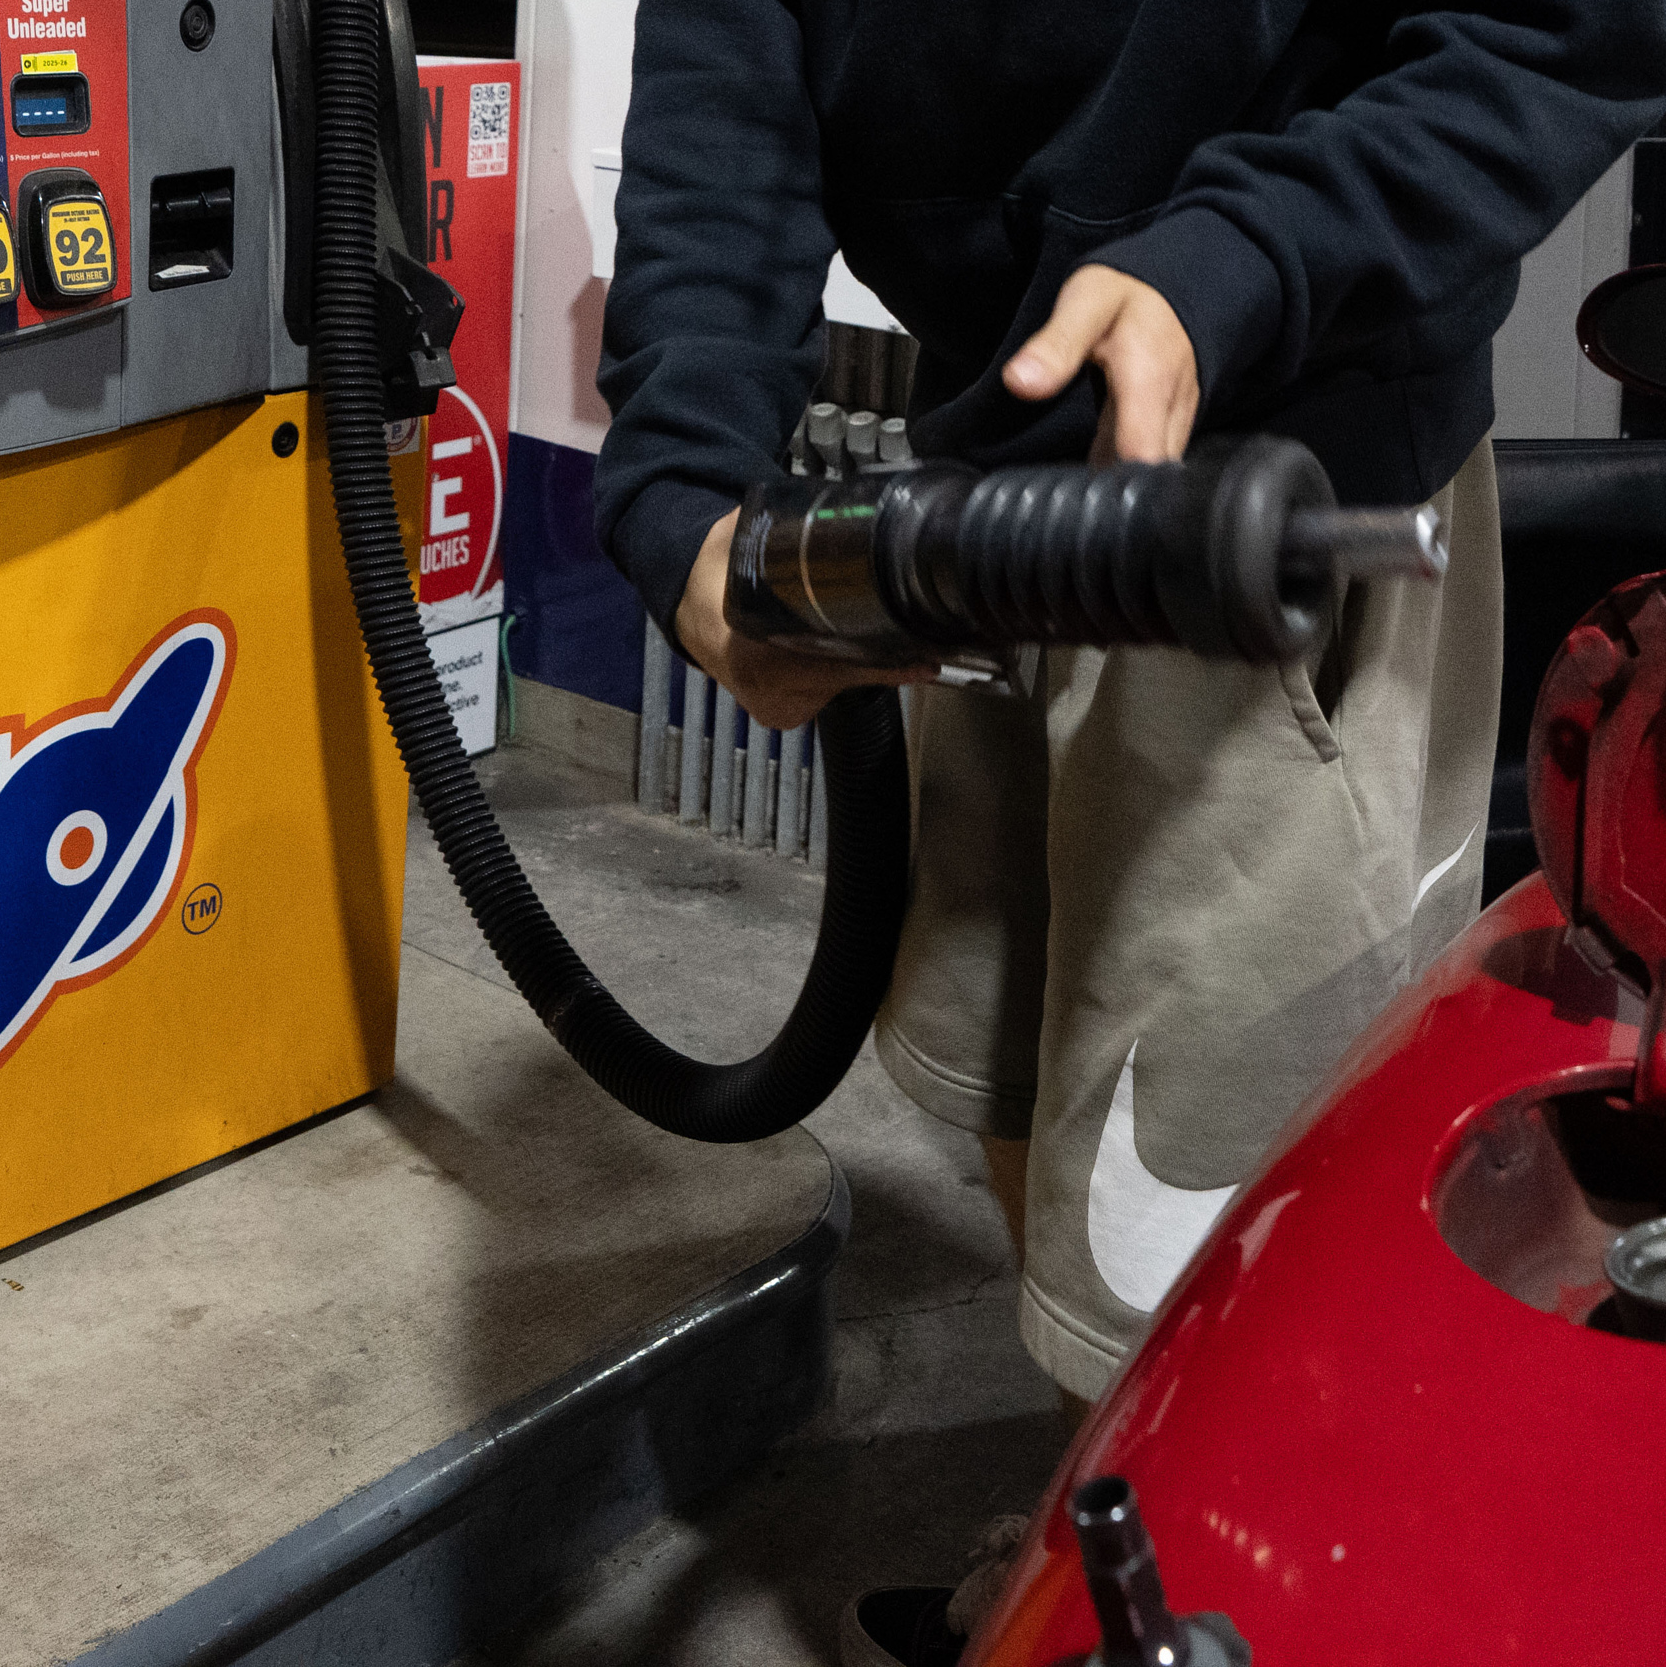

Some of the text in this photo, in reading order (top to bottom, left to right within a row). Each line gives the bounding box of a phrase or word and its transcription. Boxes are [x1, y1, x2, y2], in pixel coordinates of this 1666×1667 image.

[7, 17, 87, 39] Unleaded
[55, 227, 107, 267] 92
[66, 270, 103, 282] PUSH HERE
[420, 535, 470, 575] UCHES
[186, 894, 218, 922] TM
